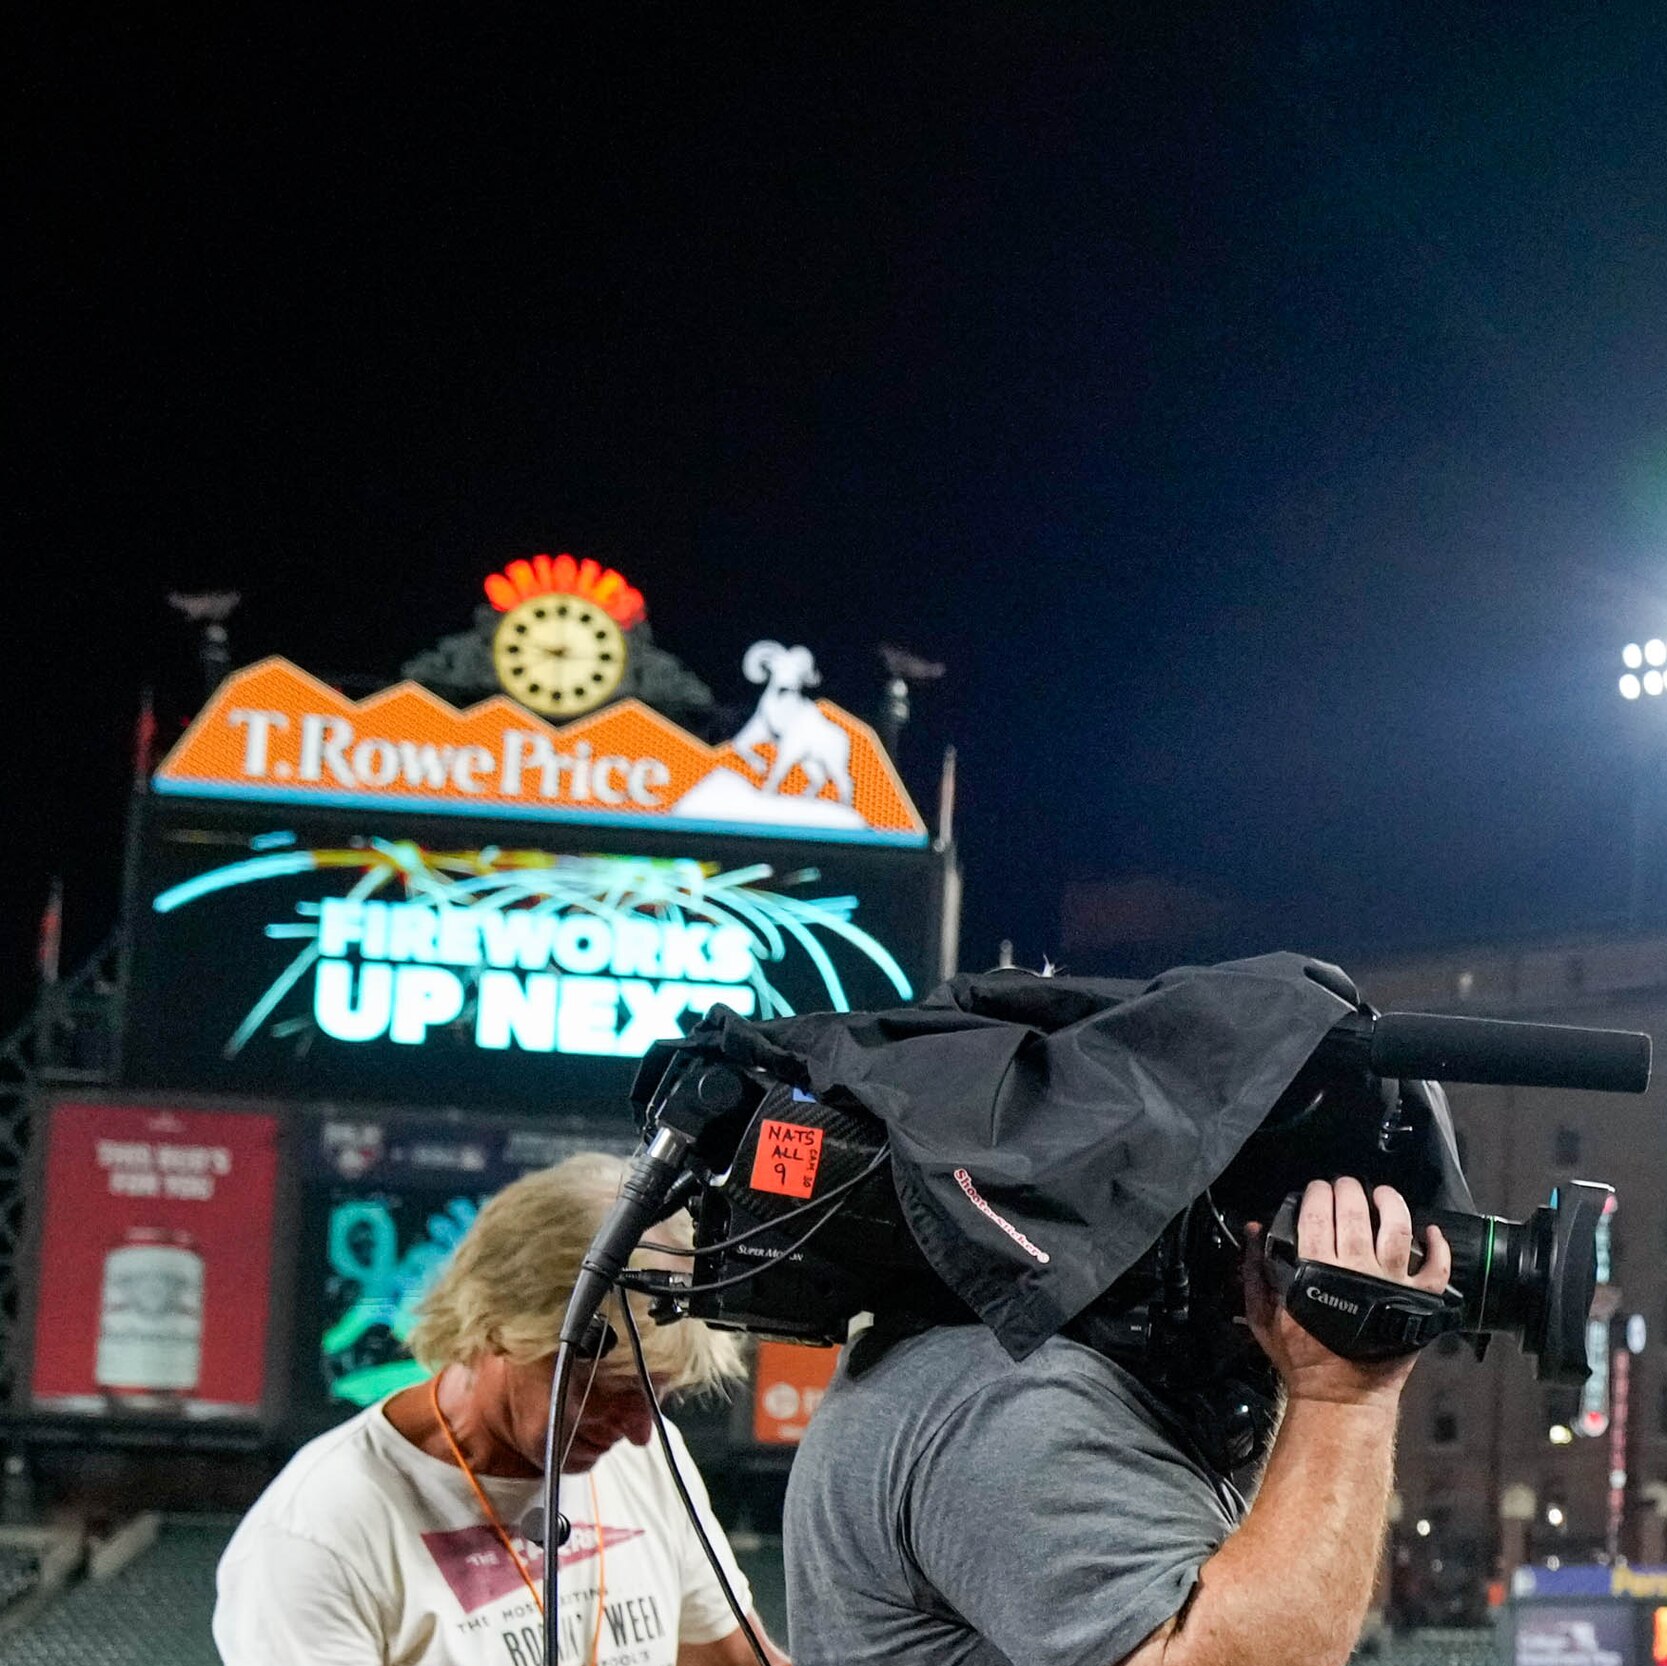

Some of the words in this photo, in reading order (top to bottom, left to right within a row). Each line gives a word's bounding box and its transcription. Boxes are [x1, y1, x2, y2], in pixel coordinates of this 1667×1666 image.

[300, 713, 496, 795] Rowe
[501, 728, 670, 808] Price
[319, 896, 755, 984] FIREWORKS
[313, 957, 465, 1046] UP
[768, 1126, 816, 1146] NATS
[771, 1146, 804, 1161] ALL
[773, 1163, 788, 1187] 9
[1305, 1286, 1360, 1316] Canon
